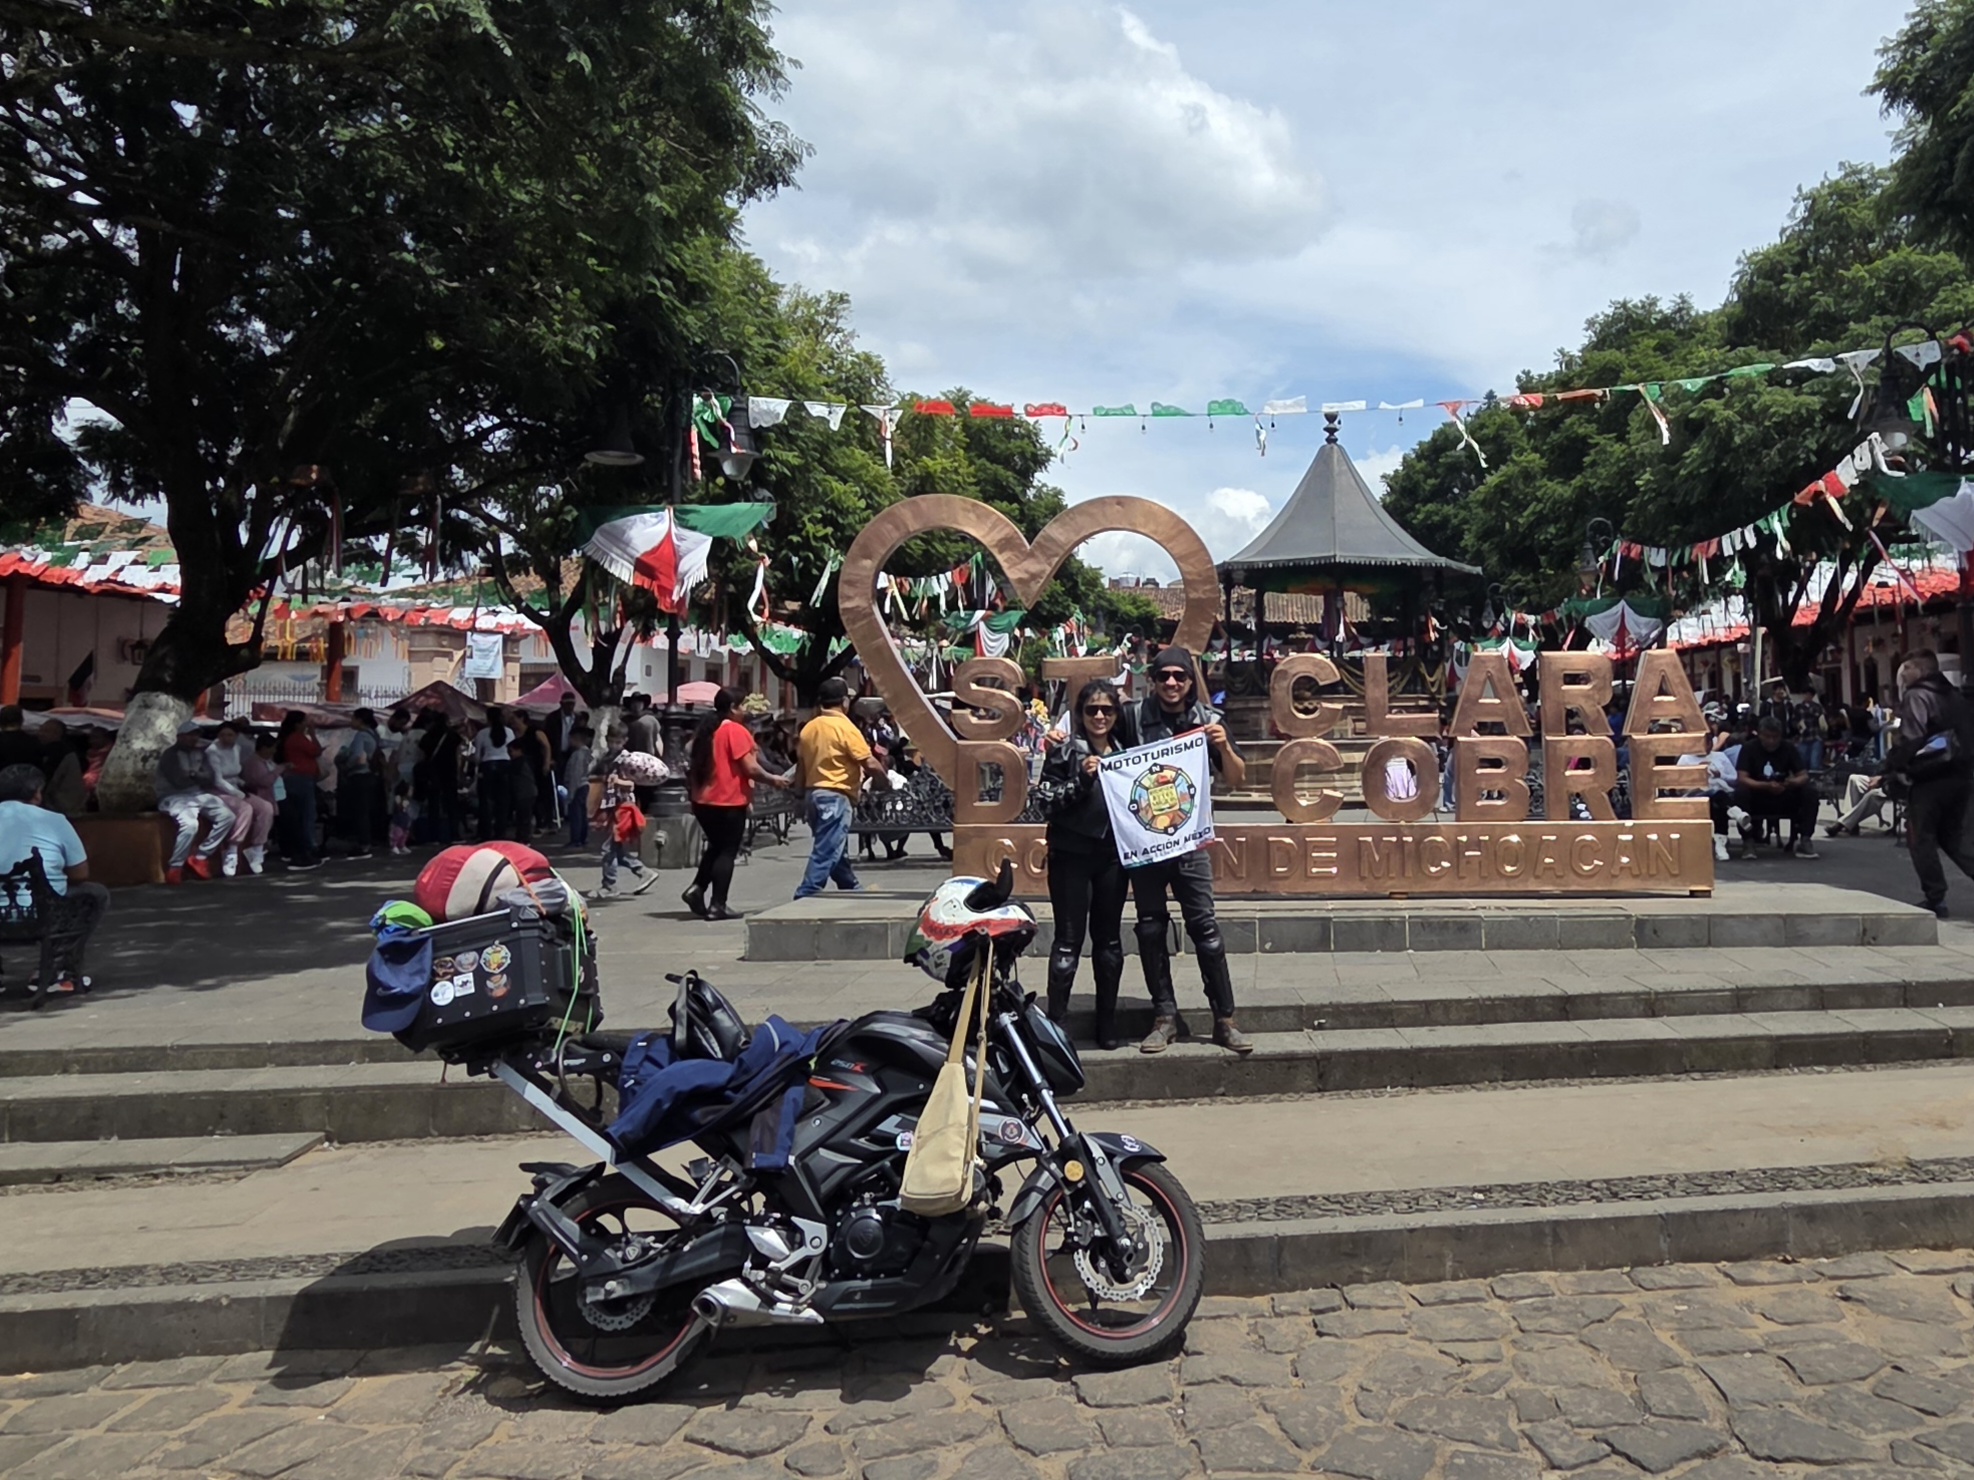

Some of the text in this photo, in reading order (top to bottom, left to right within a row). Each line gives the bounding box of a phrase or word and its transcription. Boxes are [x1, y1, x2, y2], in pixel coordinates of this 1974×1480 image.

[1270, 649, 1709, 737] CLARA
[1100, 737, 1204, 773] MOTOTURISMO
[1151, 765, 1161, 773] N
[1271, 733, 1710, 823] COBRE
[1123, 850, 1138, 860] EN
[1141, 838, 1180, 856] ACCIÓN
[1267, 836, 1338, 878] DE
